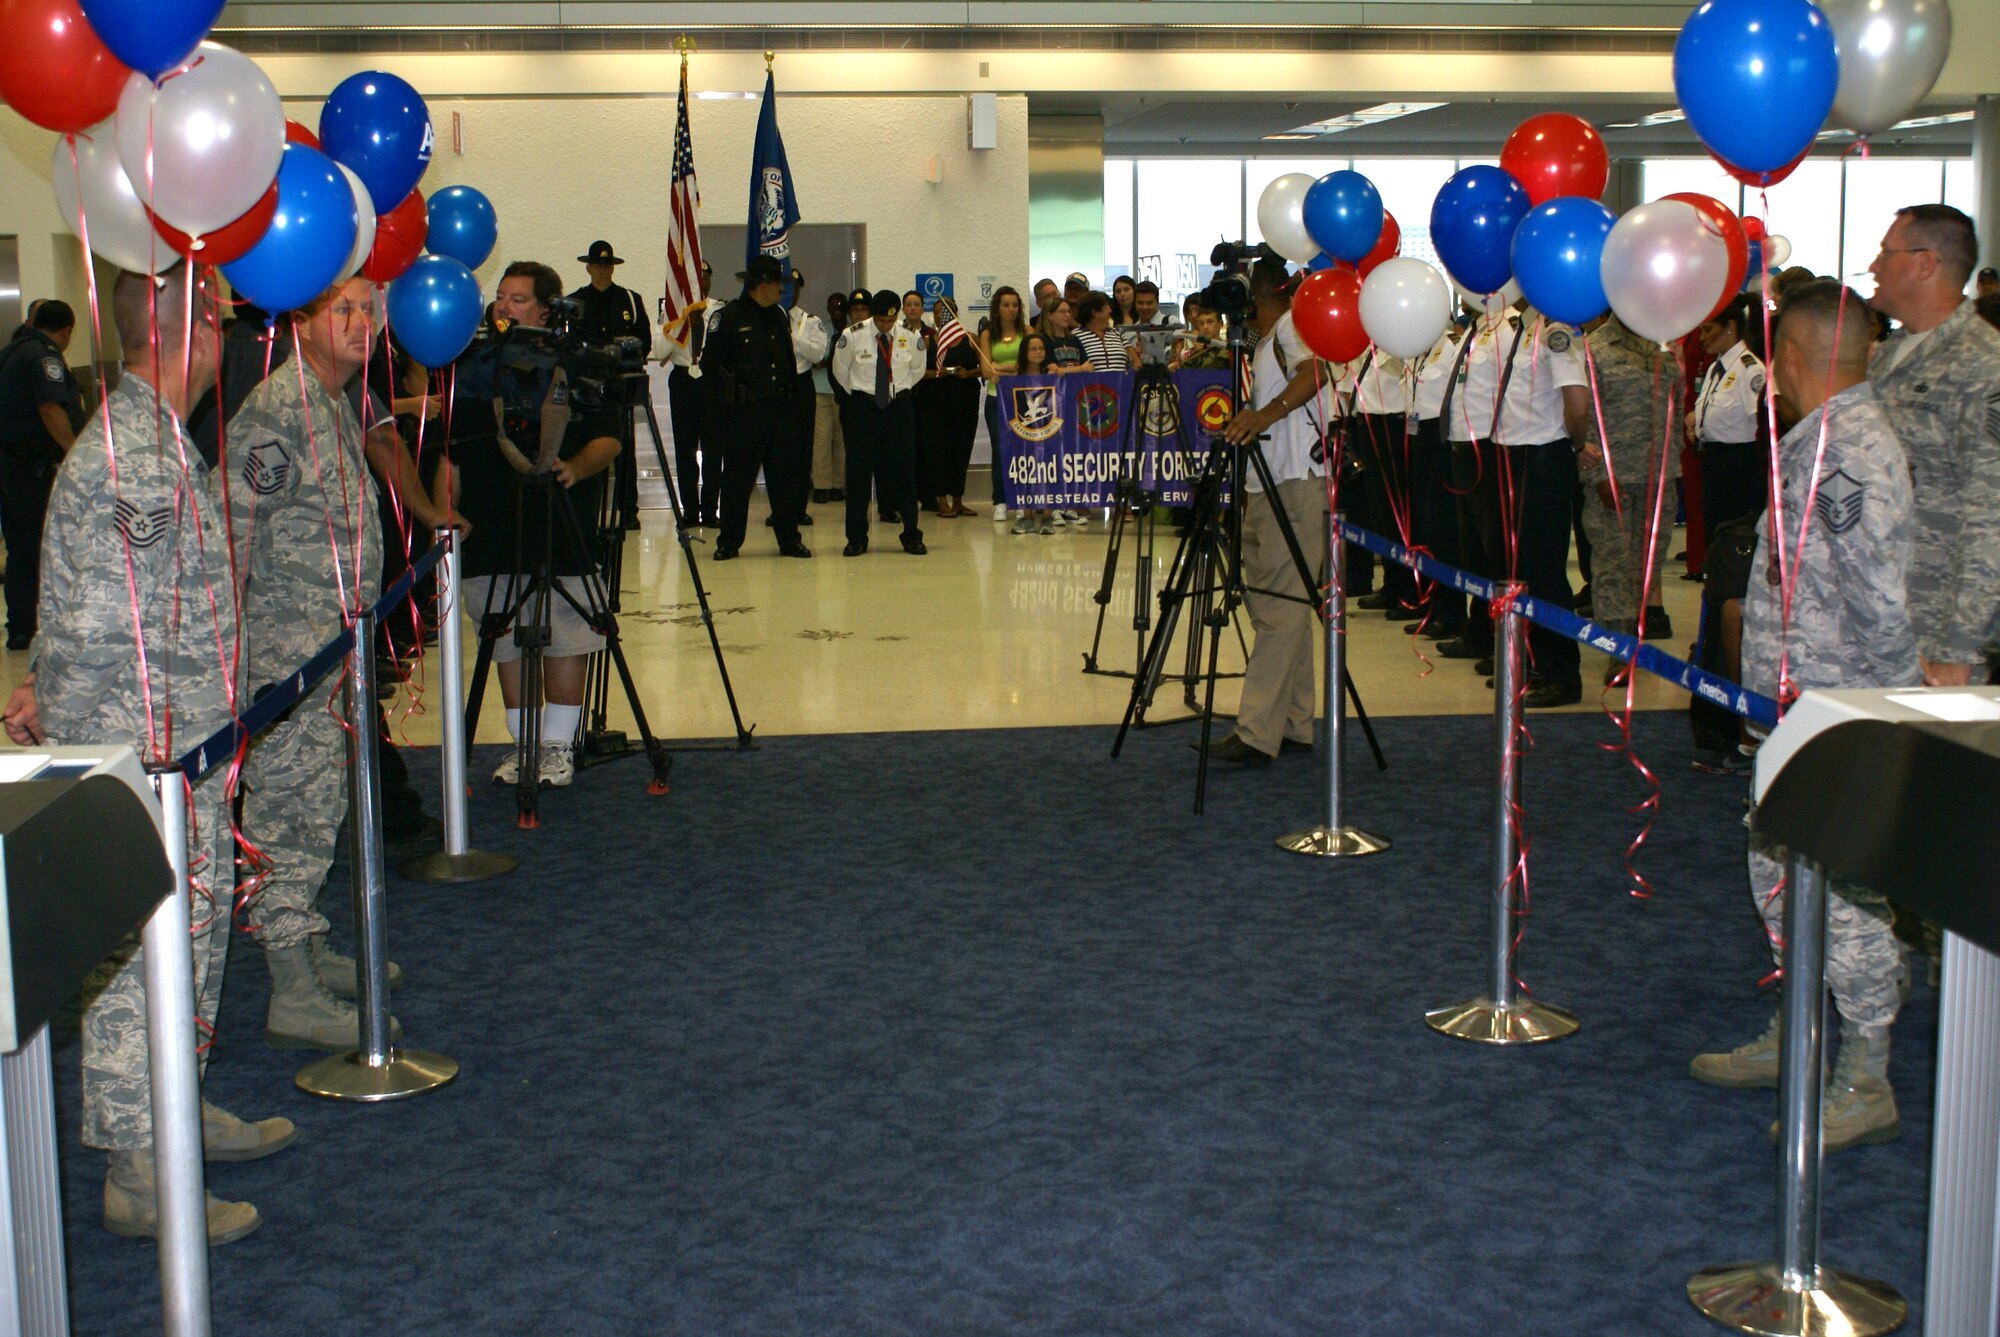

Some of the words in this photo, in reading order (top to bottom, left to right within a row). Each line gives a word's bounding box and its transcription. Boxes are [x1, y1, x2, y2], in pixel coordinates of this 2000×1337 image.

[1009, 454, 1057, 484] 482nd
[1062, 452, 1146, 483] SECURTY
[1016, 493, 1100, 505] HOMESTEAD
[1697, 678, 1729, 706] American
